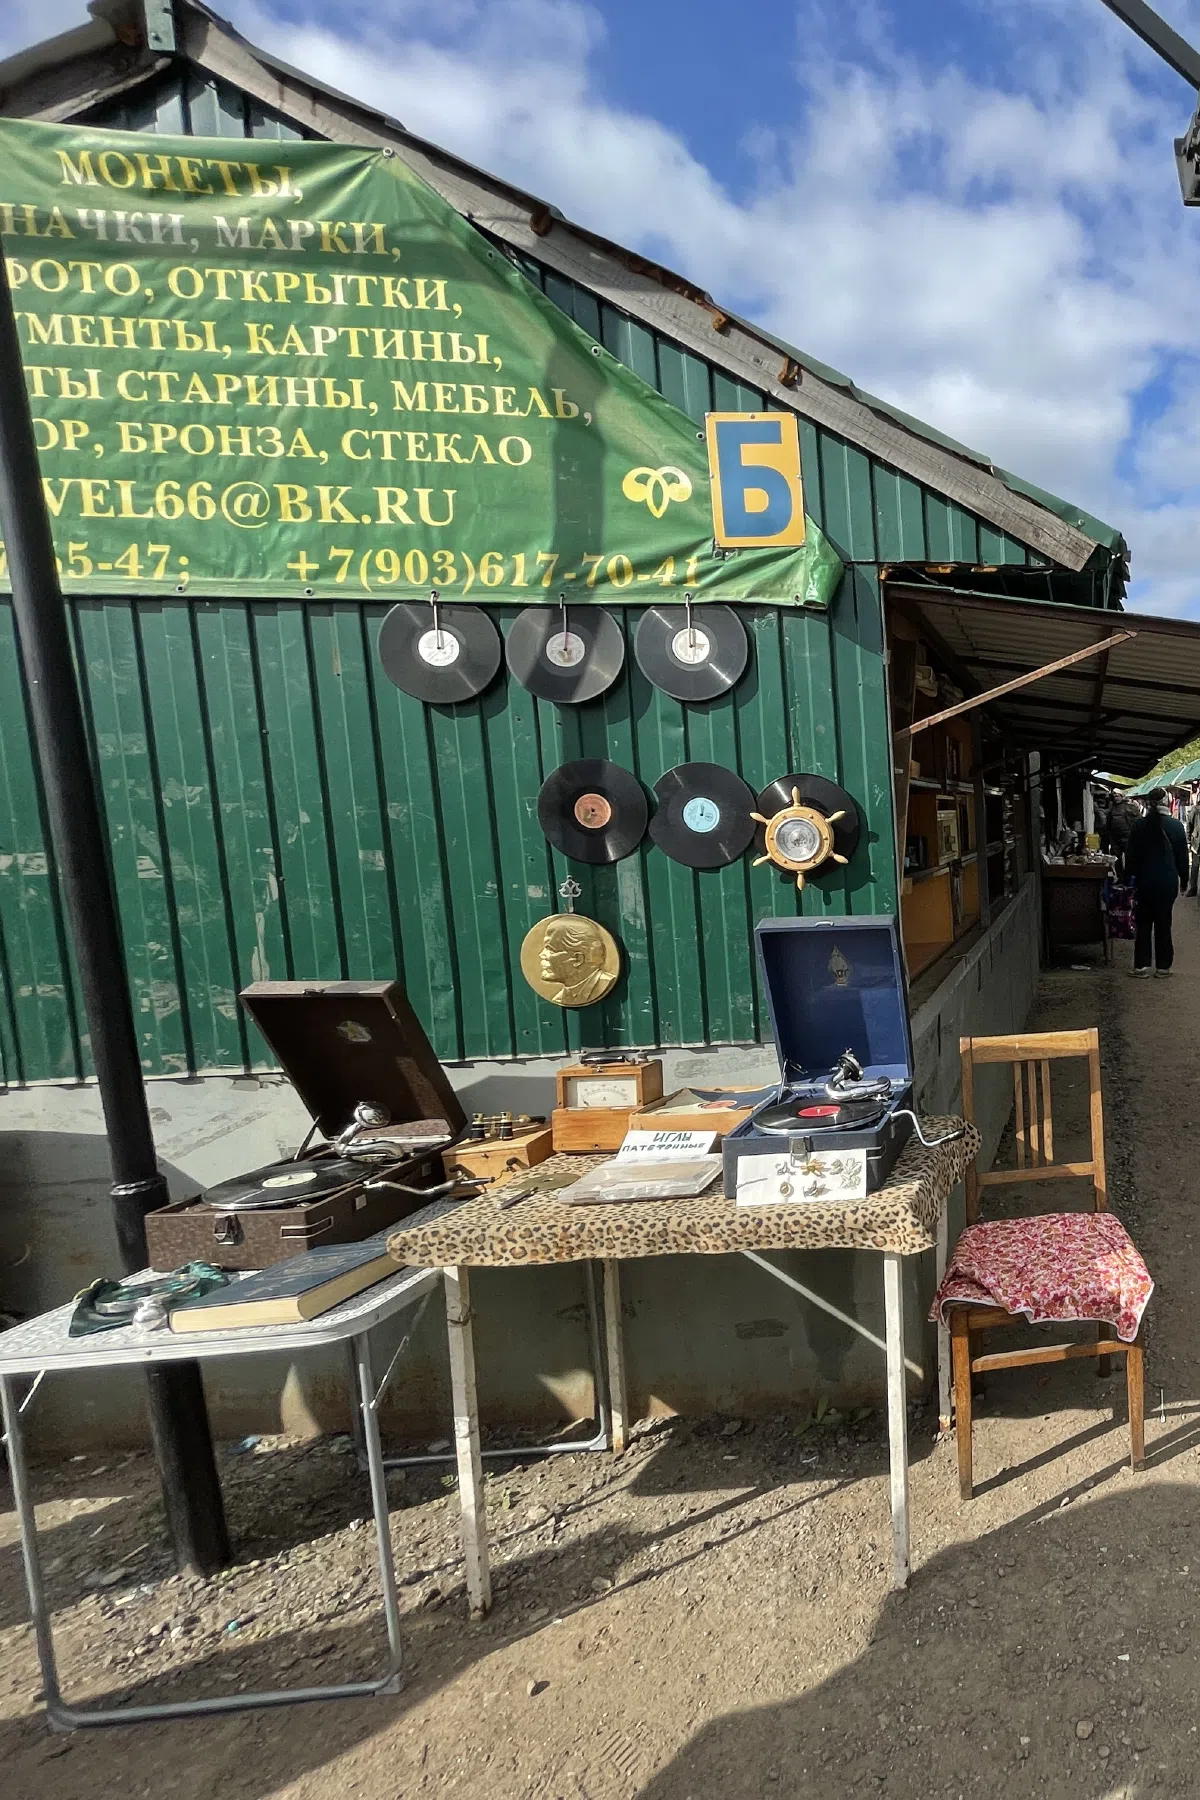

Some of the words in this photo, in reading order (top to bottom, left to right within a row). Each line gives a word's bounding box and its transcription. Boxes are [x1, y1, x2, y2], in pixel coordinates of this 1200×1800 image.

[55, 149, 303, 204] МОНЕТЫ,
[213, 215, 401, 262] МАРКИ,
[168, 267, 462, 319] ОТКРЫТКИ,
[14, 311, 232, 359] МЕНТЫ,
[244, 322, 502, 372] КАРТИНЫ,
[117, 370, 378, 416] СТАРИНЫ,
[391, 382, 593, 426] МЕБЕЛЬ,
[116, 421, 329, 465] БРОНЗА,
[341, 429, 532, 466] СТЕКЛО
[715, 420, 794, 537] Б
[622, 1143, 706, 1152] ПАТЕФОННЫЕ
[653, 1132, 692, 1142] ИГЛЫ
